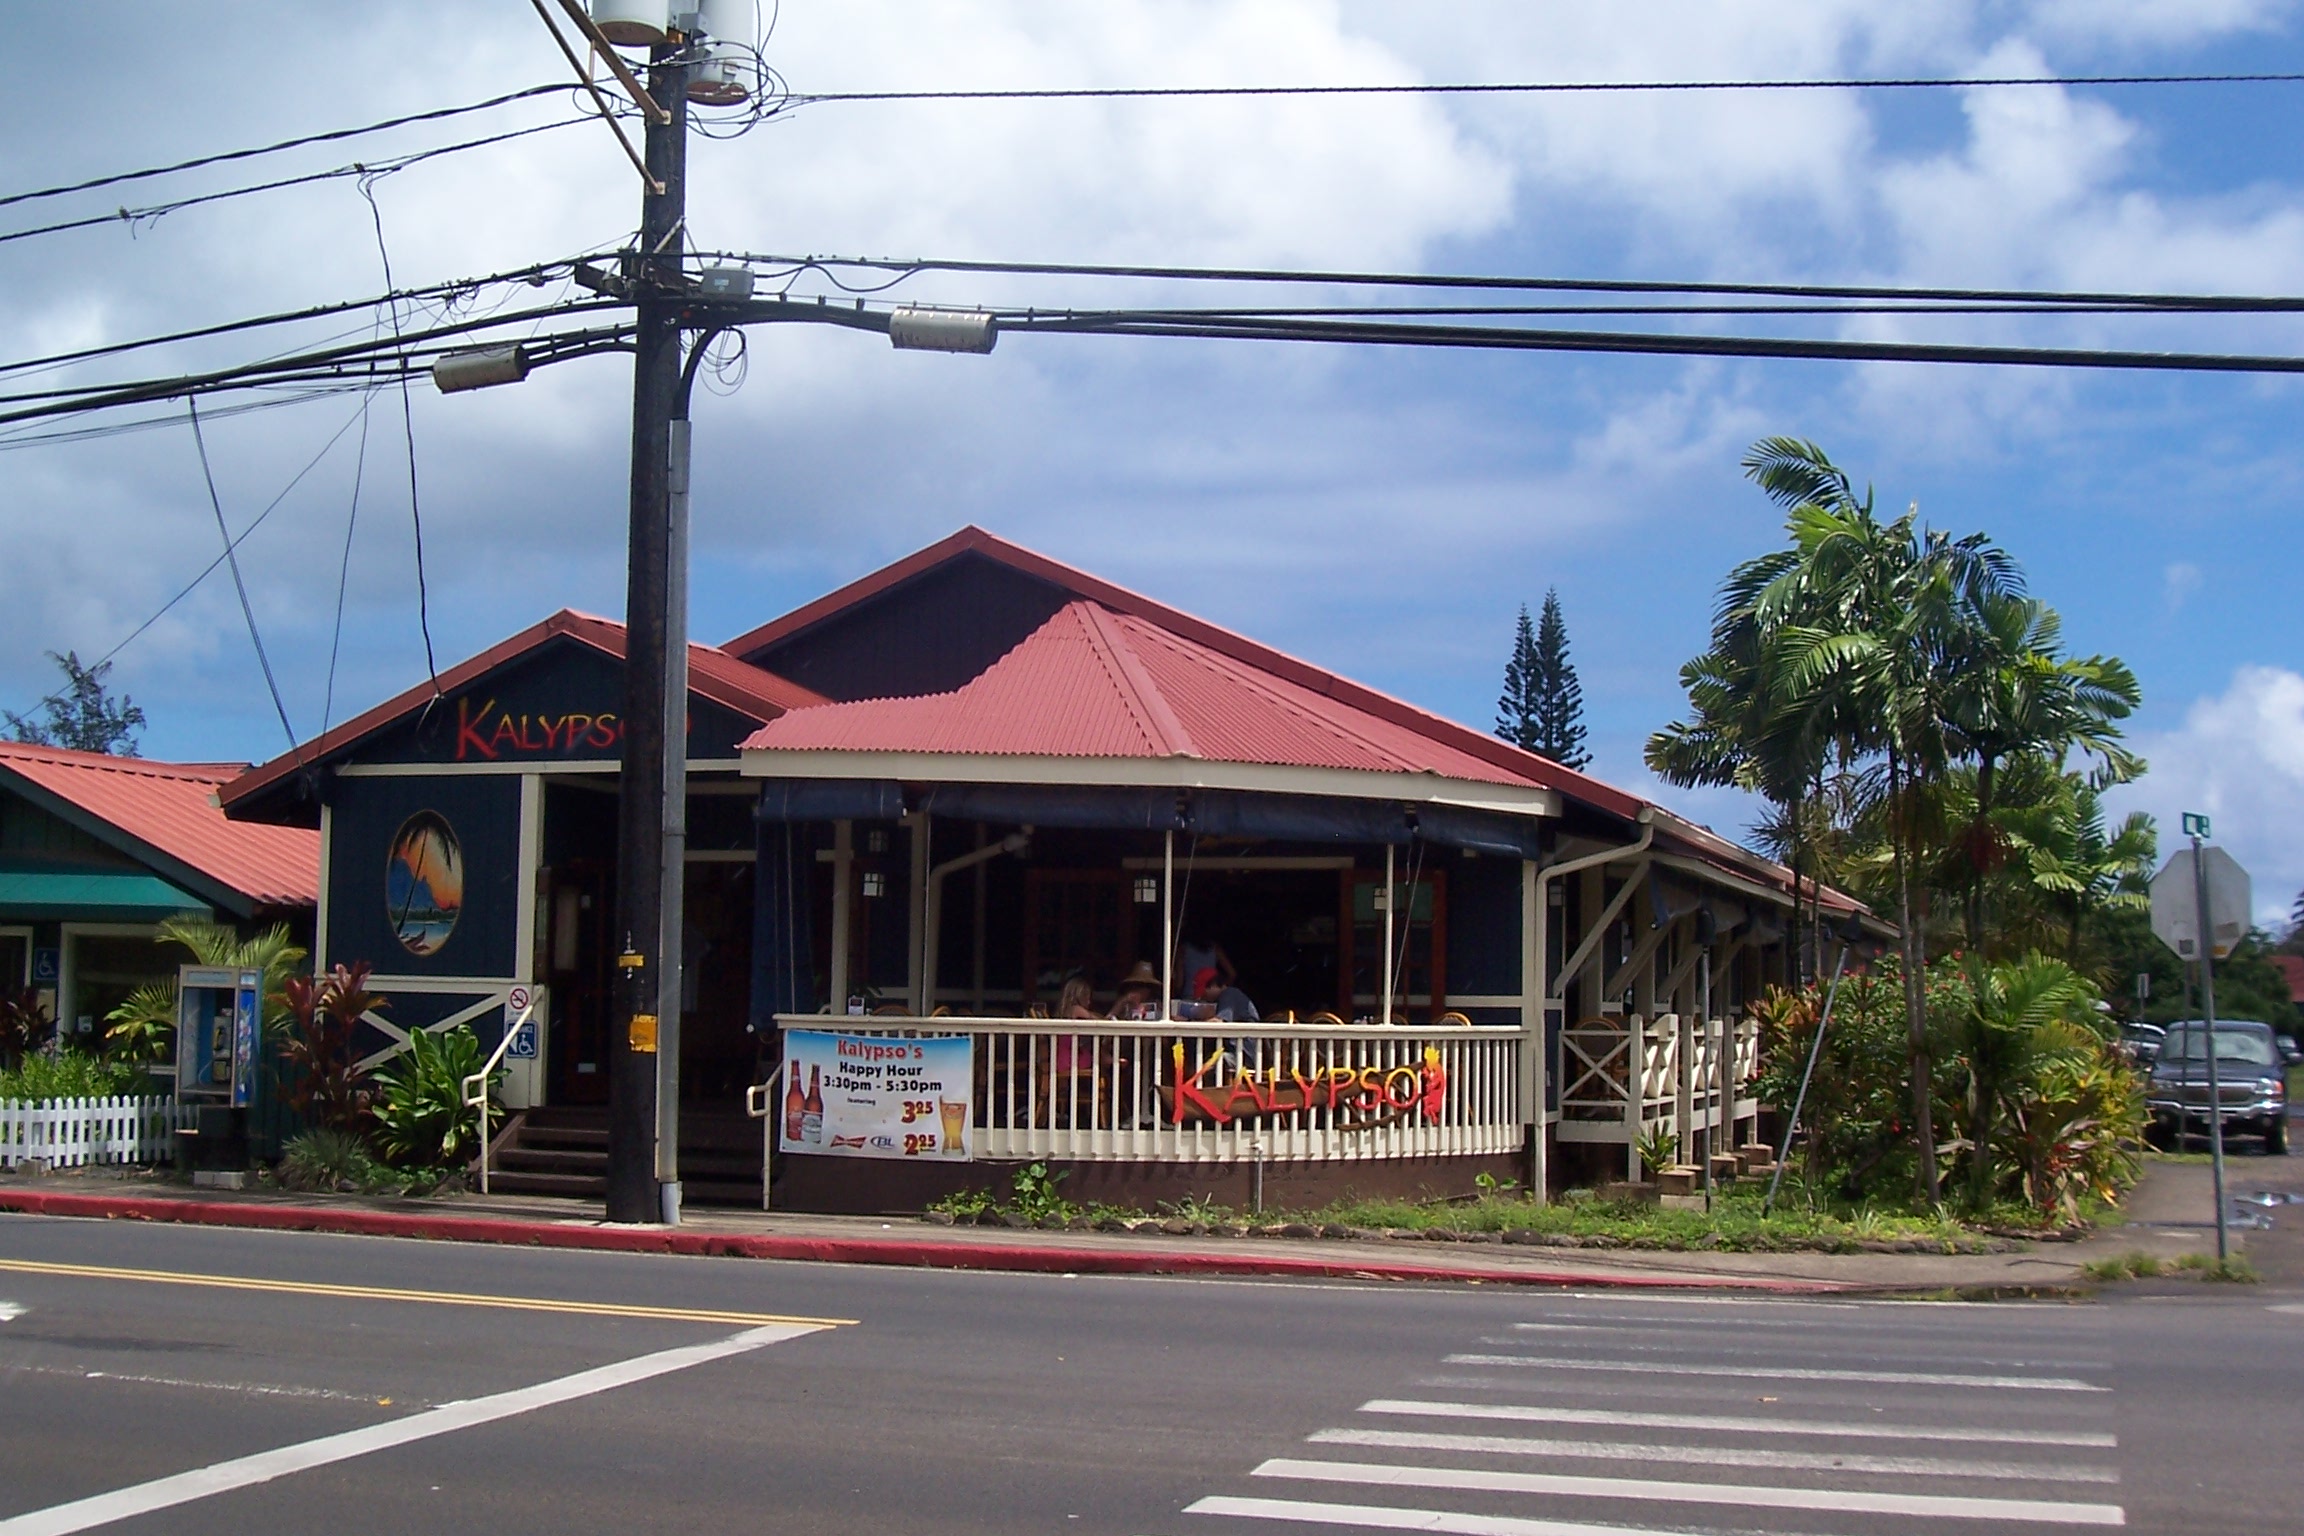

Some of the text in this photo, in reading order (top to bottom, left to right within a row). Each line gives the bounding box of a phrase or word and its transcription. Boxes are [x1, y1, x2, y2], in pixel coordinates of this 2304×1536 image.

[456, 697, 625, 760] KALYPS
[838, 1040, 923, 1061] Kalypso's
[840, 1062, 923, 1078] Happy Hour
[823, 1075, 872, 1092] 3:30pm
[886, 1080, 942, 1093] 5:30pm
[1171, 1043, 1418, 1124] KALYPSO
